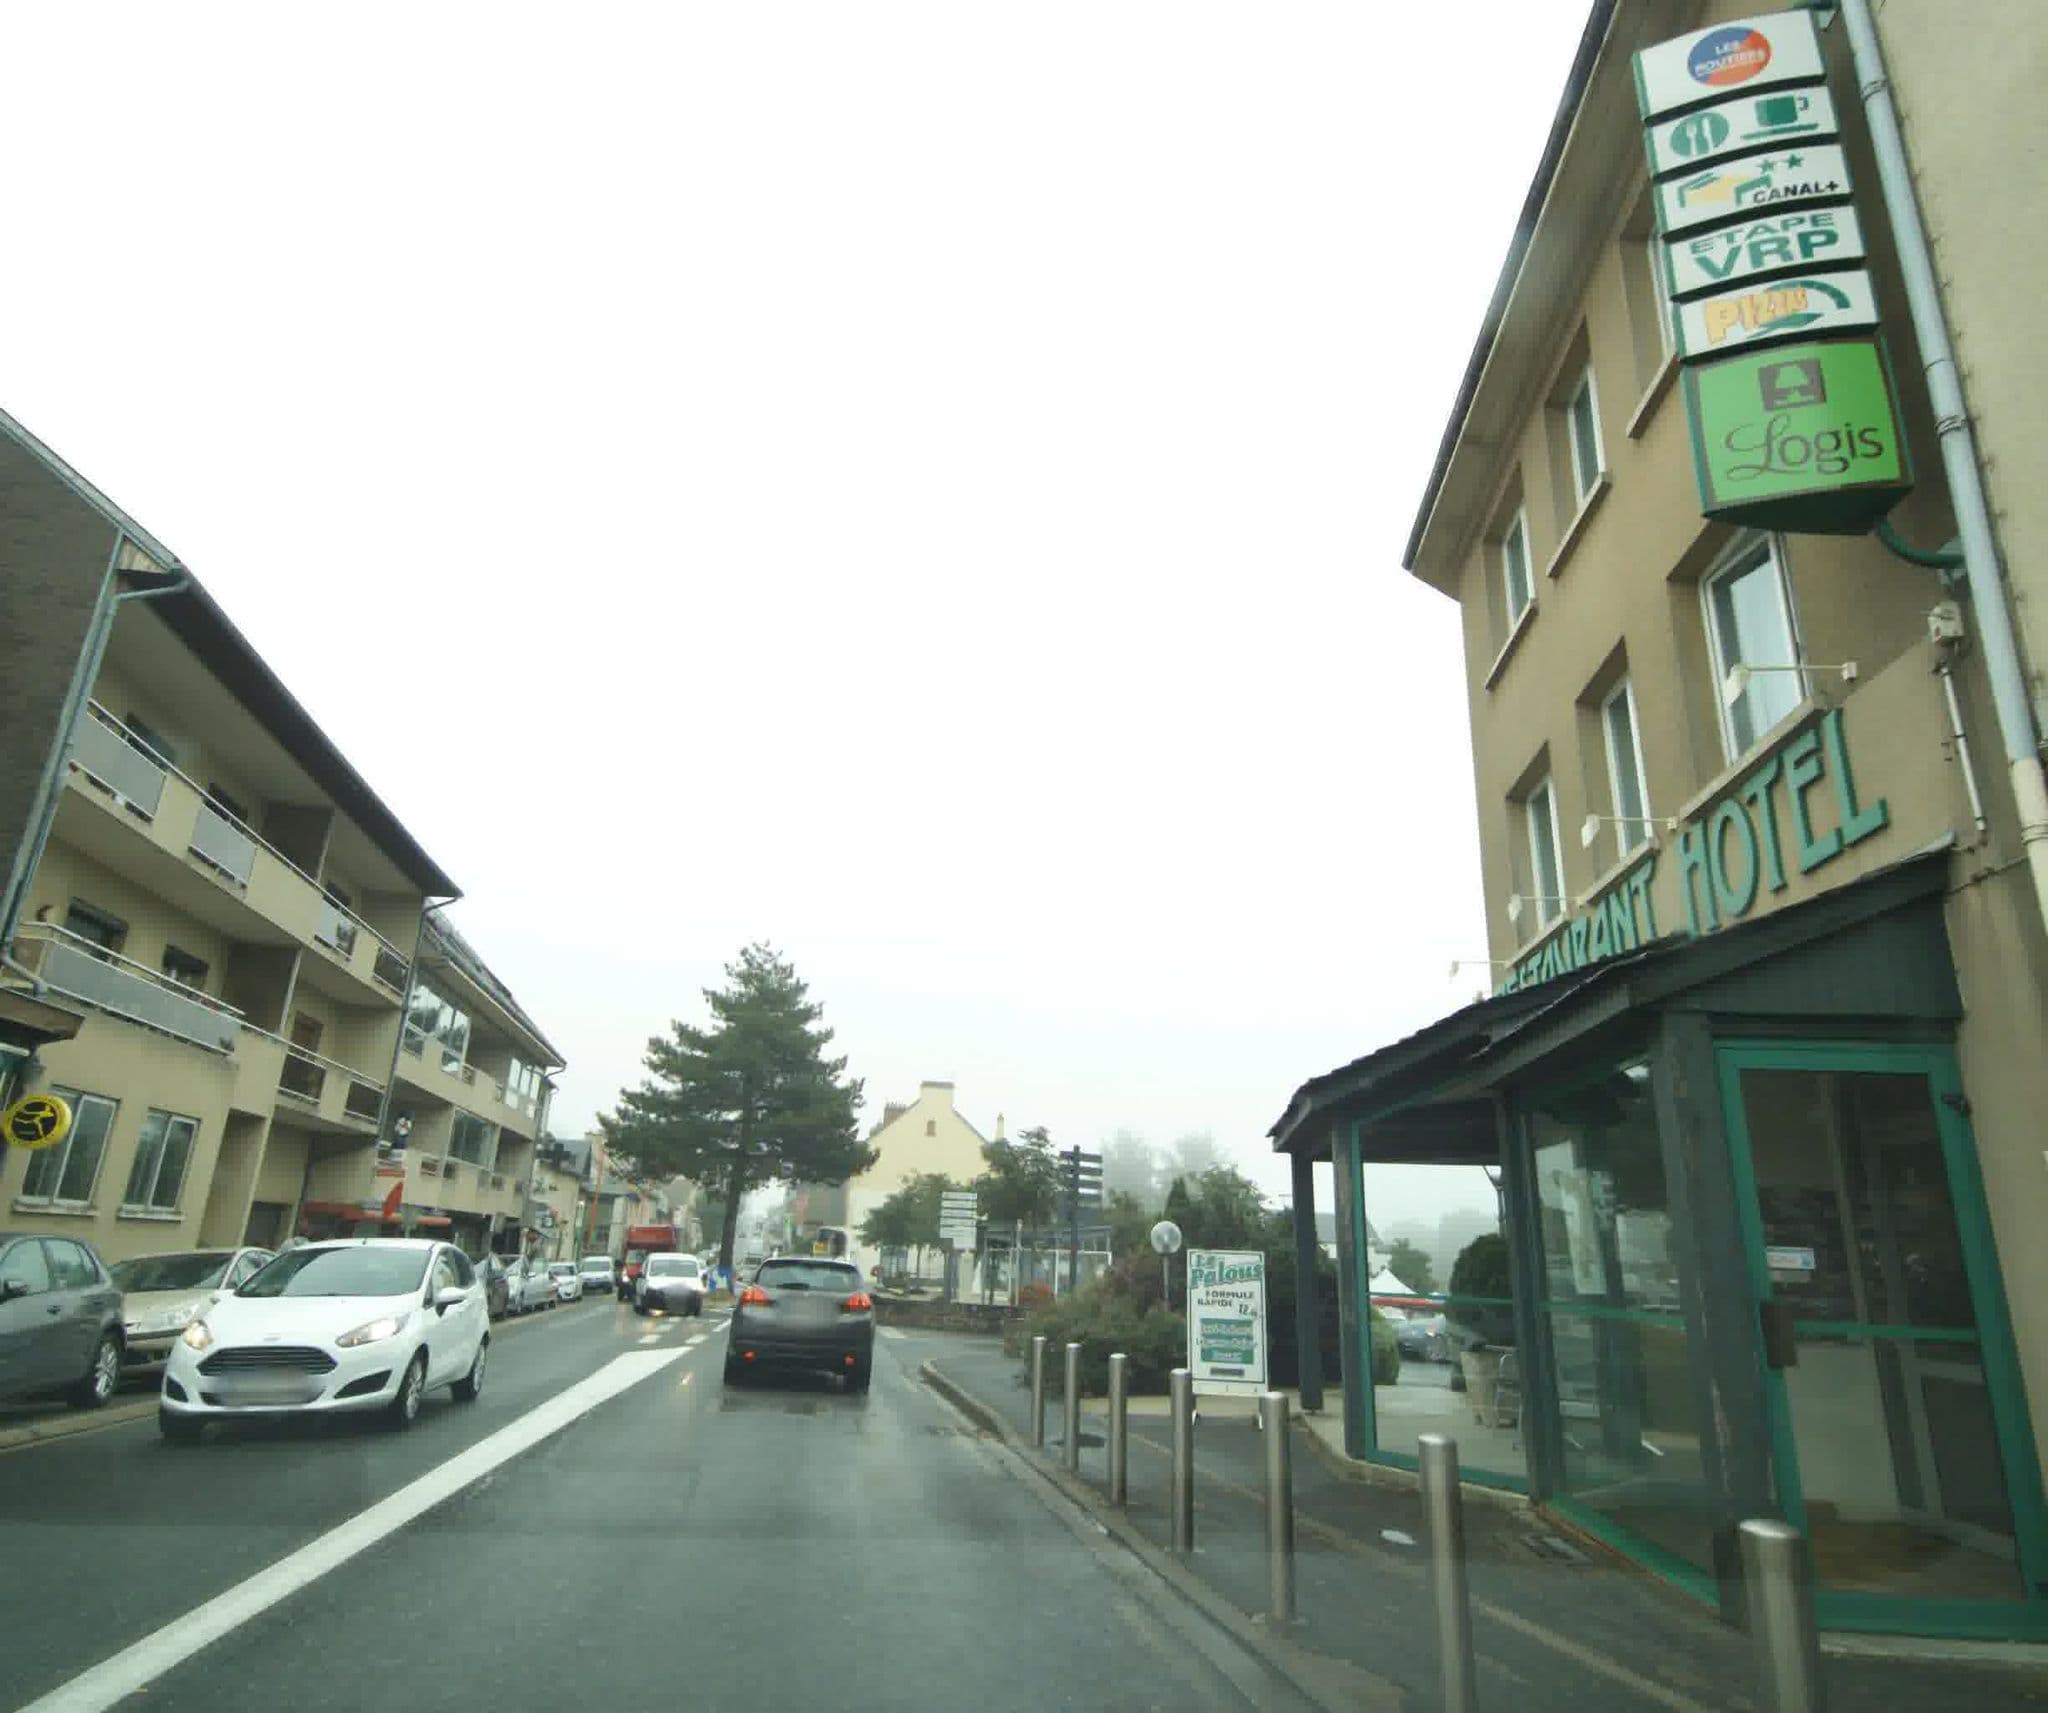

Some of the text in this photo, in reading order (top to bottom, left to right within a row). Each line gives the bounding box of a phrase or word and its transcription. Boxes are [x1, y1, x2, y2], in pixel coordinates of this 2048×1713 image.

[1753, 181, 1839, 203] CANAL+
[1690, 213, 1834, 255] ETAPE
[1694, 229, 1839, 280] VRP
[1725, 413, 1883, 480] Logis
[1677, 707, 1888, 939] HOTEL
